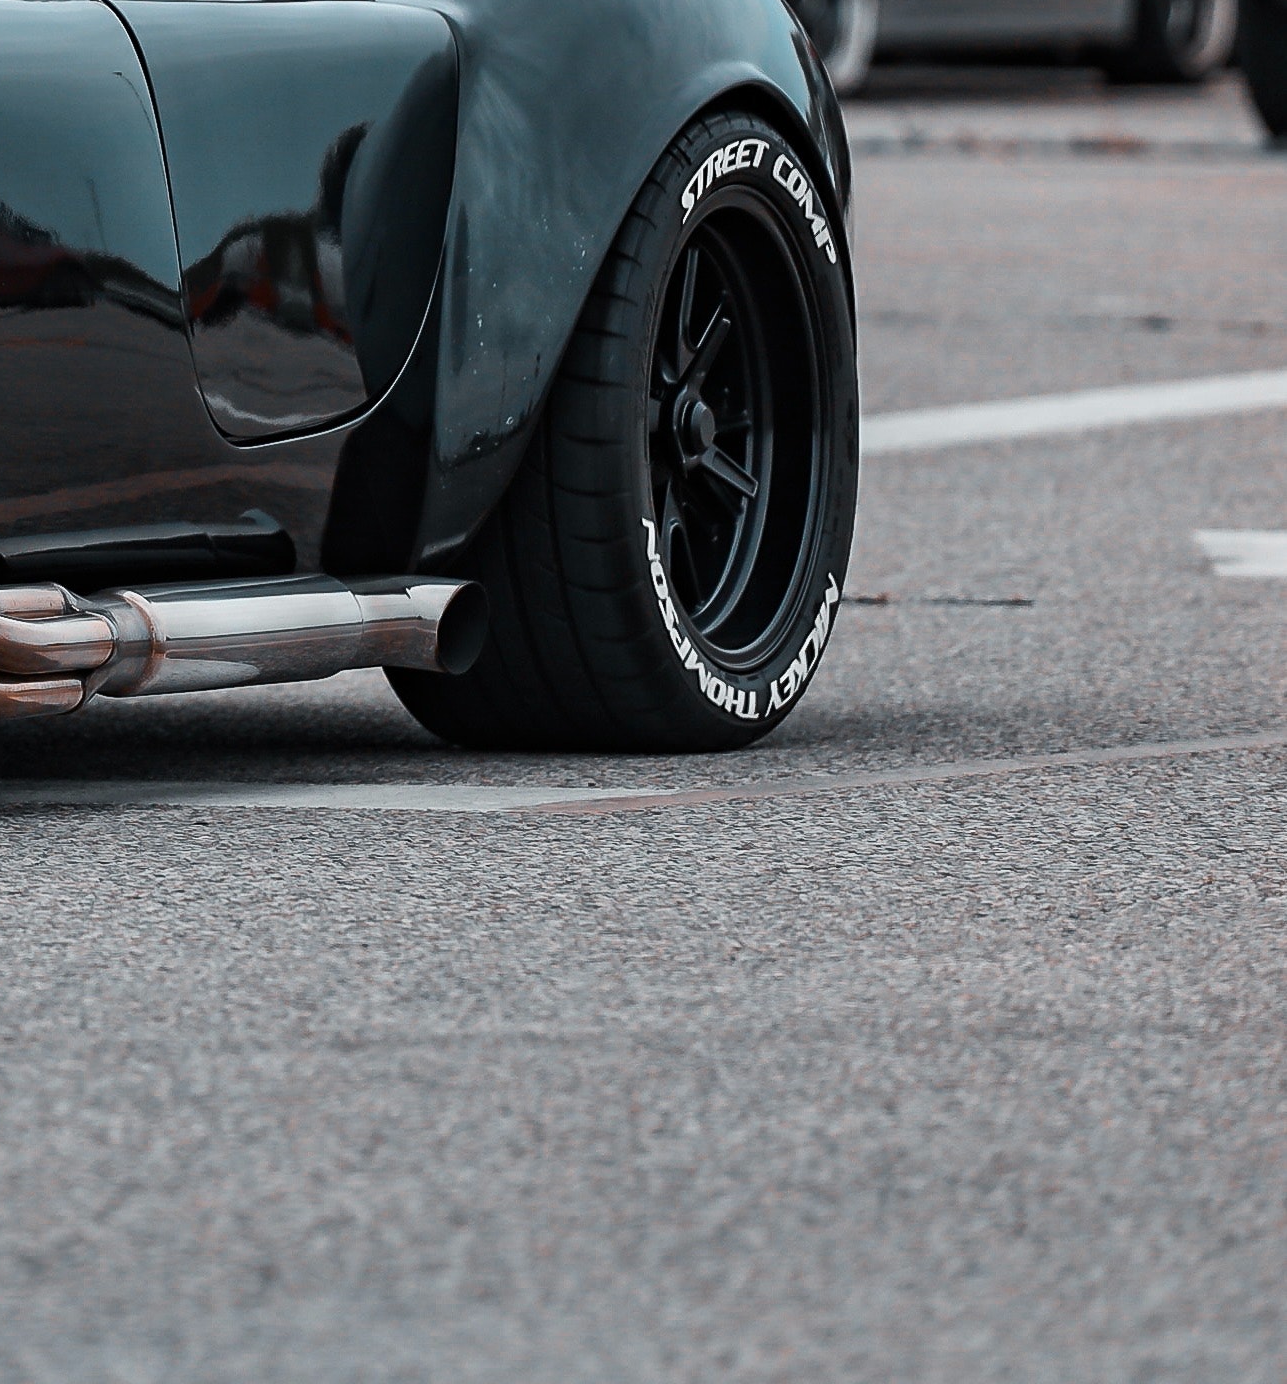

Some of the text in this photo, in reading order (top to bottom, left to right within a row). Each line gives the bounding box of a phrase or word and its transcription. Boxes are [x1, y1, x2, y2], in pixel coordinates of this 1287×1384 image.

[681, 138, 837, 265] STREET COMP
[641, 517, 839, 719] MICKEY THOMPSON
